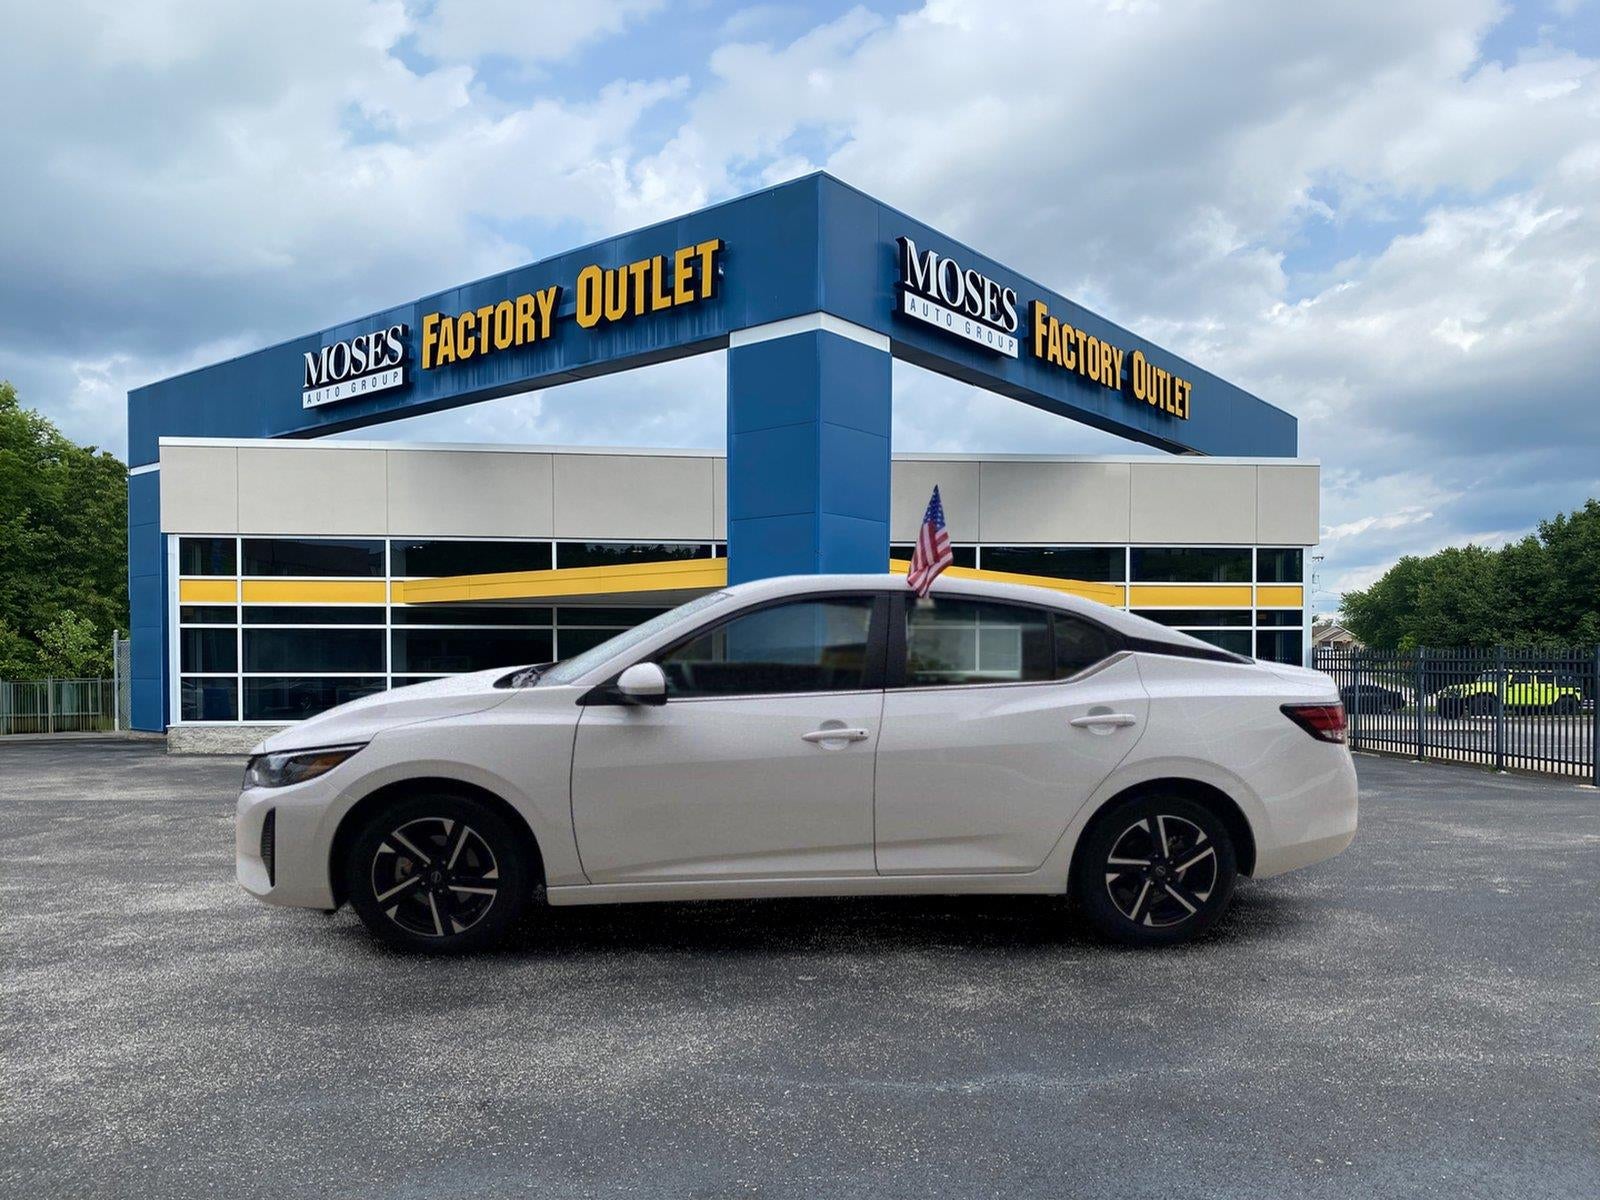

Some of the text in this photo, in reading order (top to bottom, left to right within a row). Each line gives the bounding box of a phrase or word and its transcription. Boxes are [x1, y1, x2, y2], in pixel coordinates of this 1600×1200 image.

[421, 238, 719, 369] FACTORY OUTLET
[904, 236, 1018, 333] MOSES
[303, 324, 403, 388] MOSES
[910, 298, 1014, 352] AUTO GROUP
[1034, 300, 1192, 420] FACTORY OUTLET
[306, 370, 399, 404] AUTO GROUP
